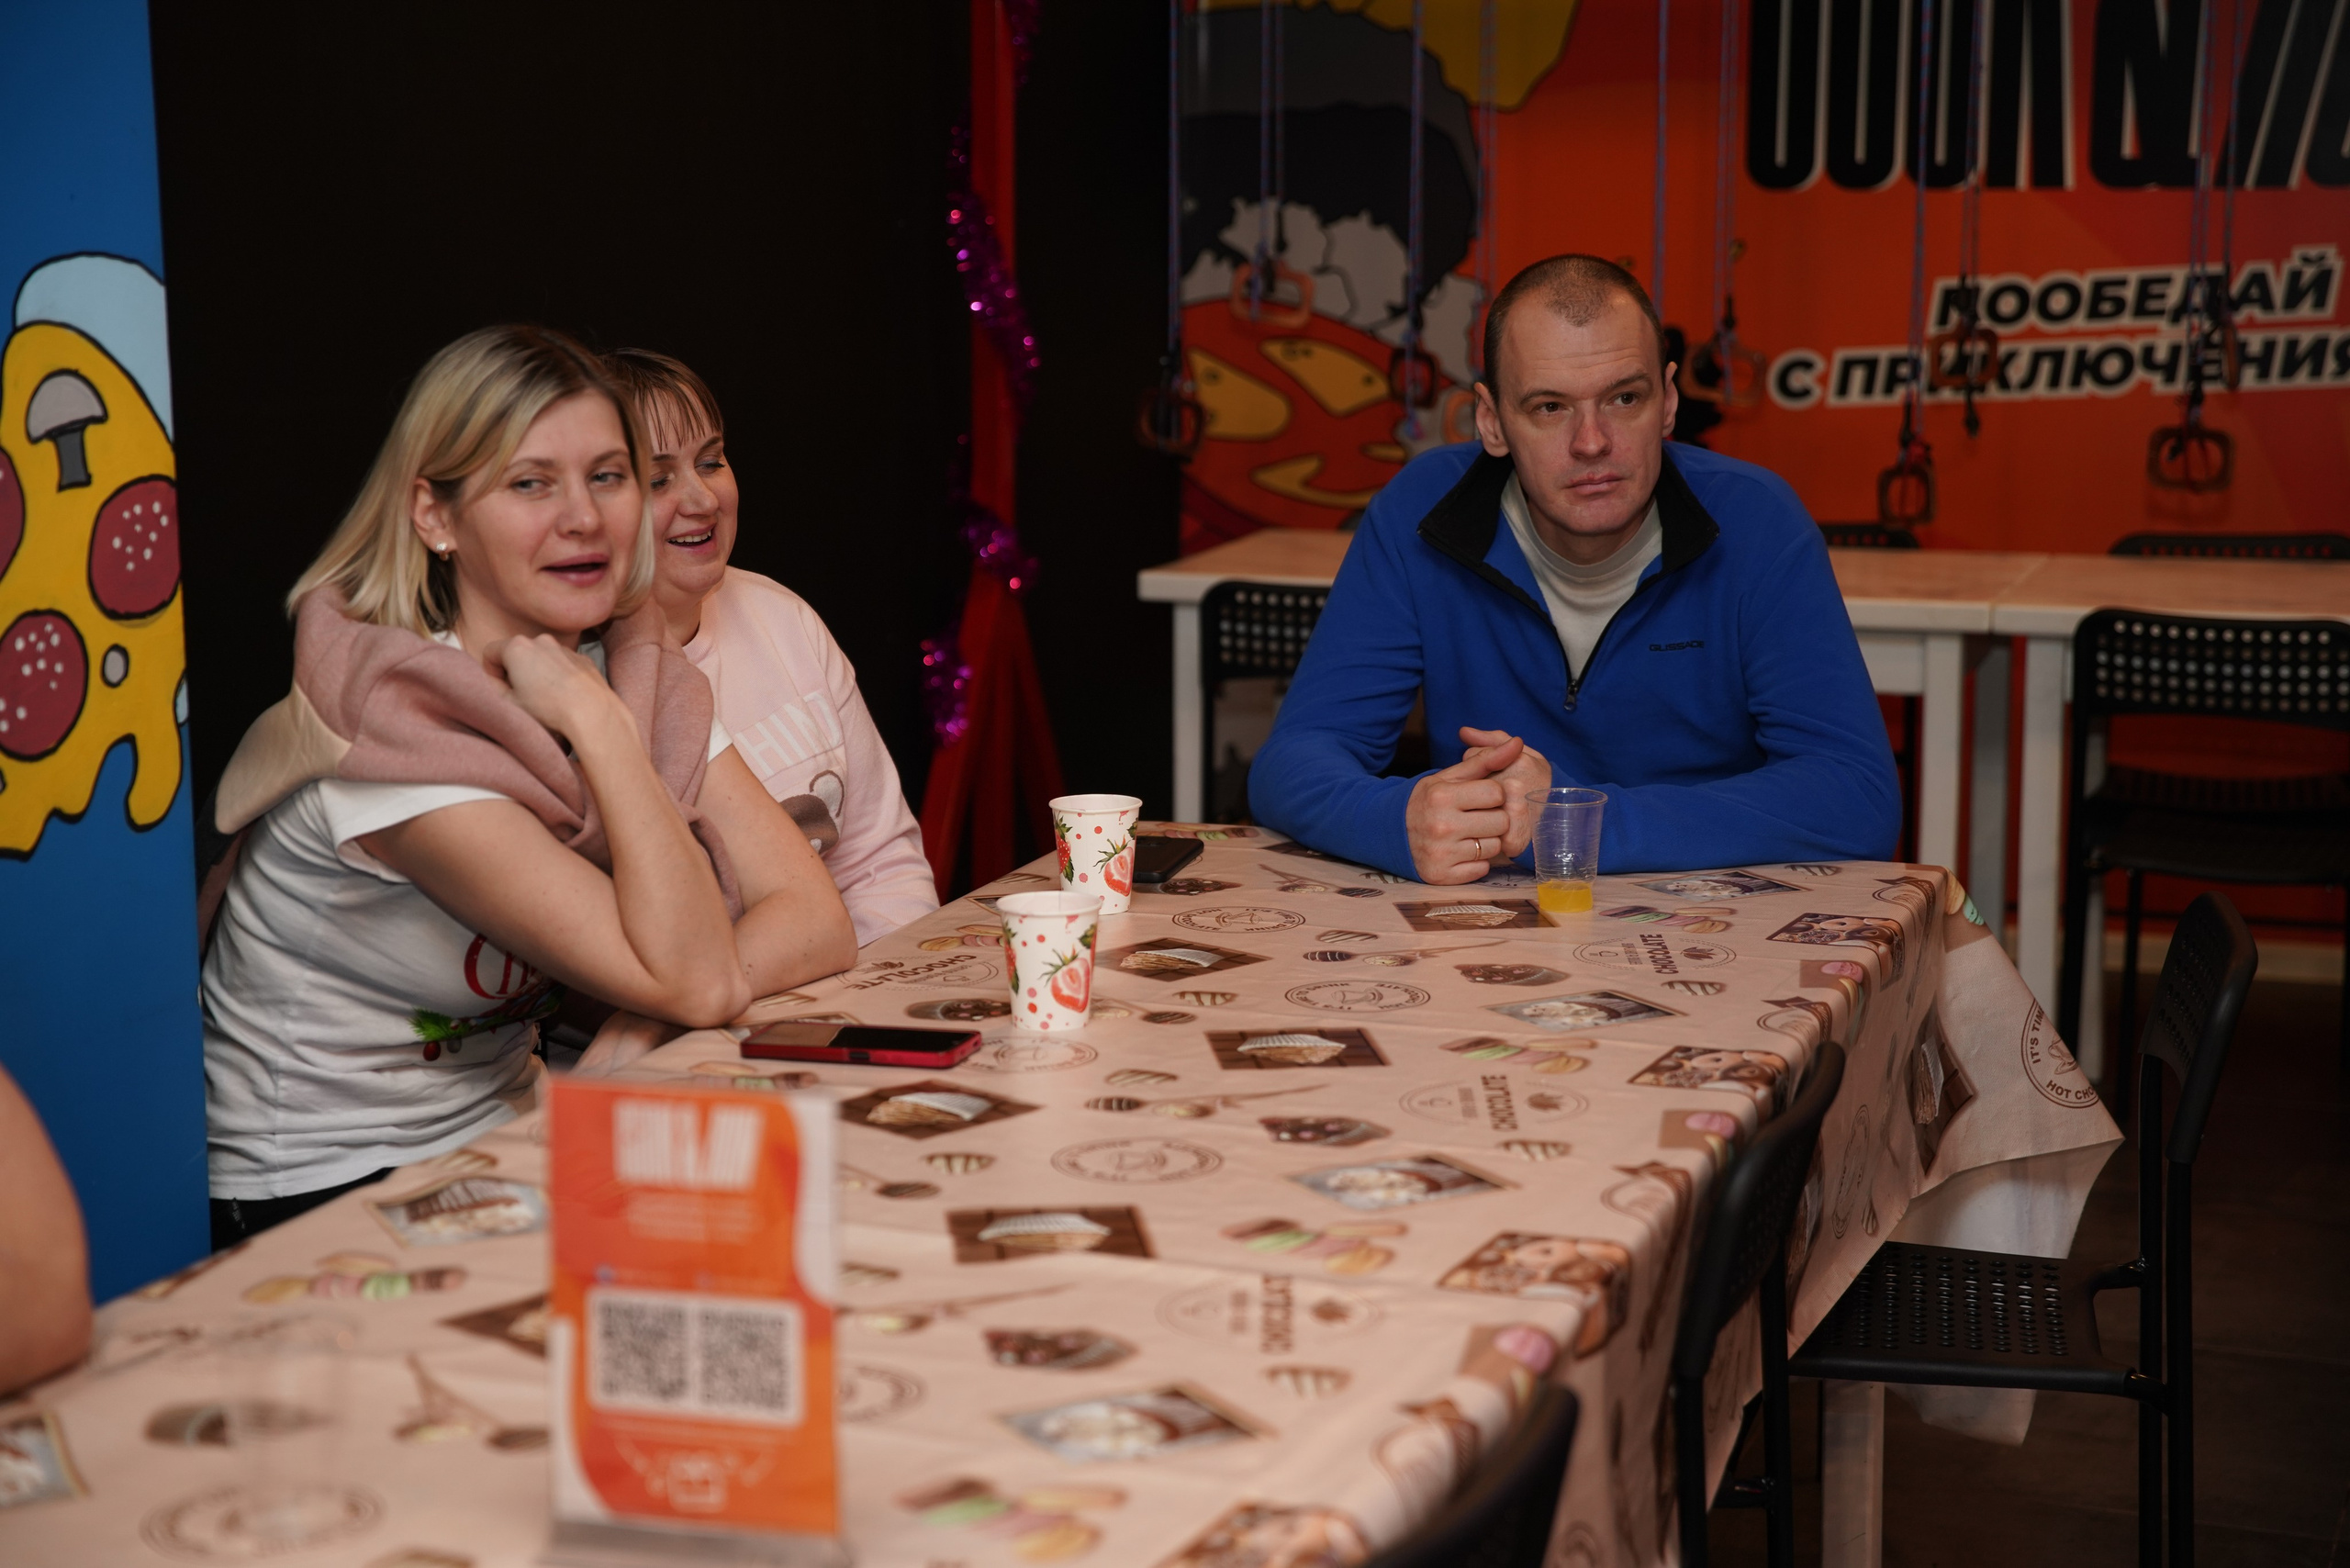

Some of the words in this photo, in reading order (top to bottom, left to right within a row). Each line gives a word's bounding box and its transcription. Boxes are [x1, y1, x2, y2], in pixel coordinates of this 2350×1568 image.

[1938, 253, 2333, 326] ПООБЕДАЙ
[1777, 360, 1815, 398] С
[844, 954, 978, 991] CHOCOLATE
[1639, 934, 1679, 975] CHOCOLATE
[2030, 1037, 2042, 1064] IT'S
[2045, 1079, 2072, 1099] HOT
